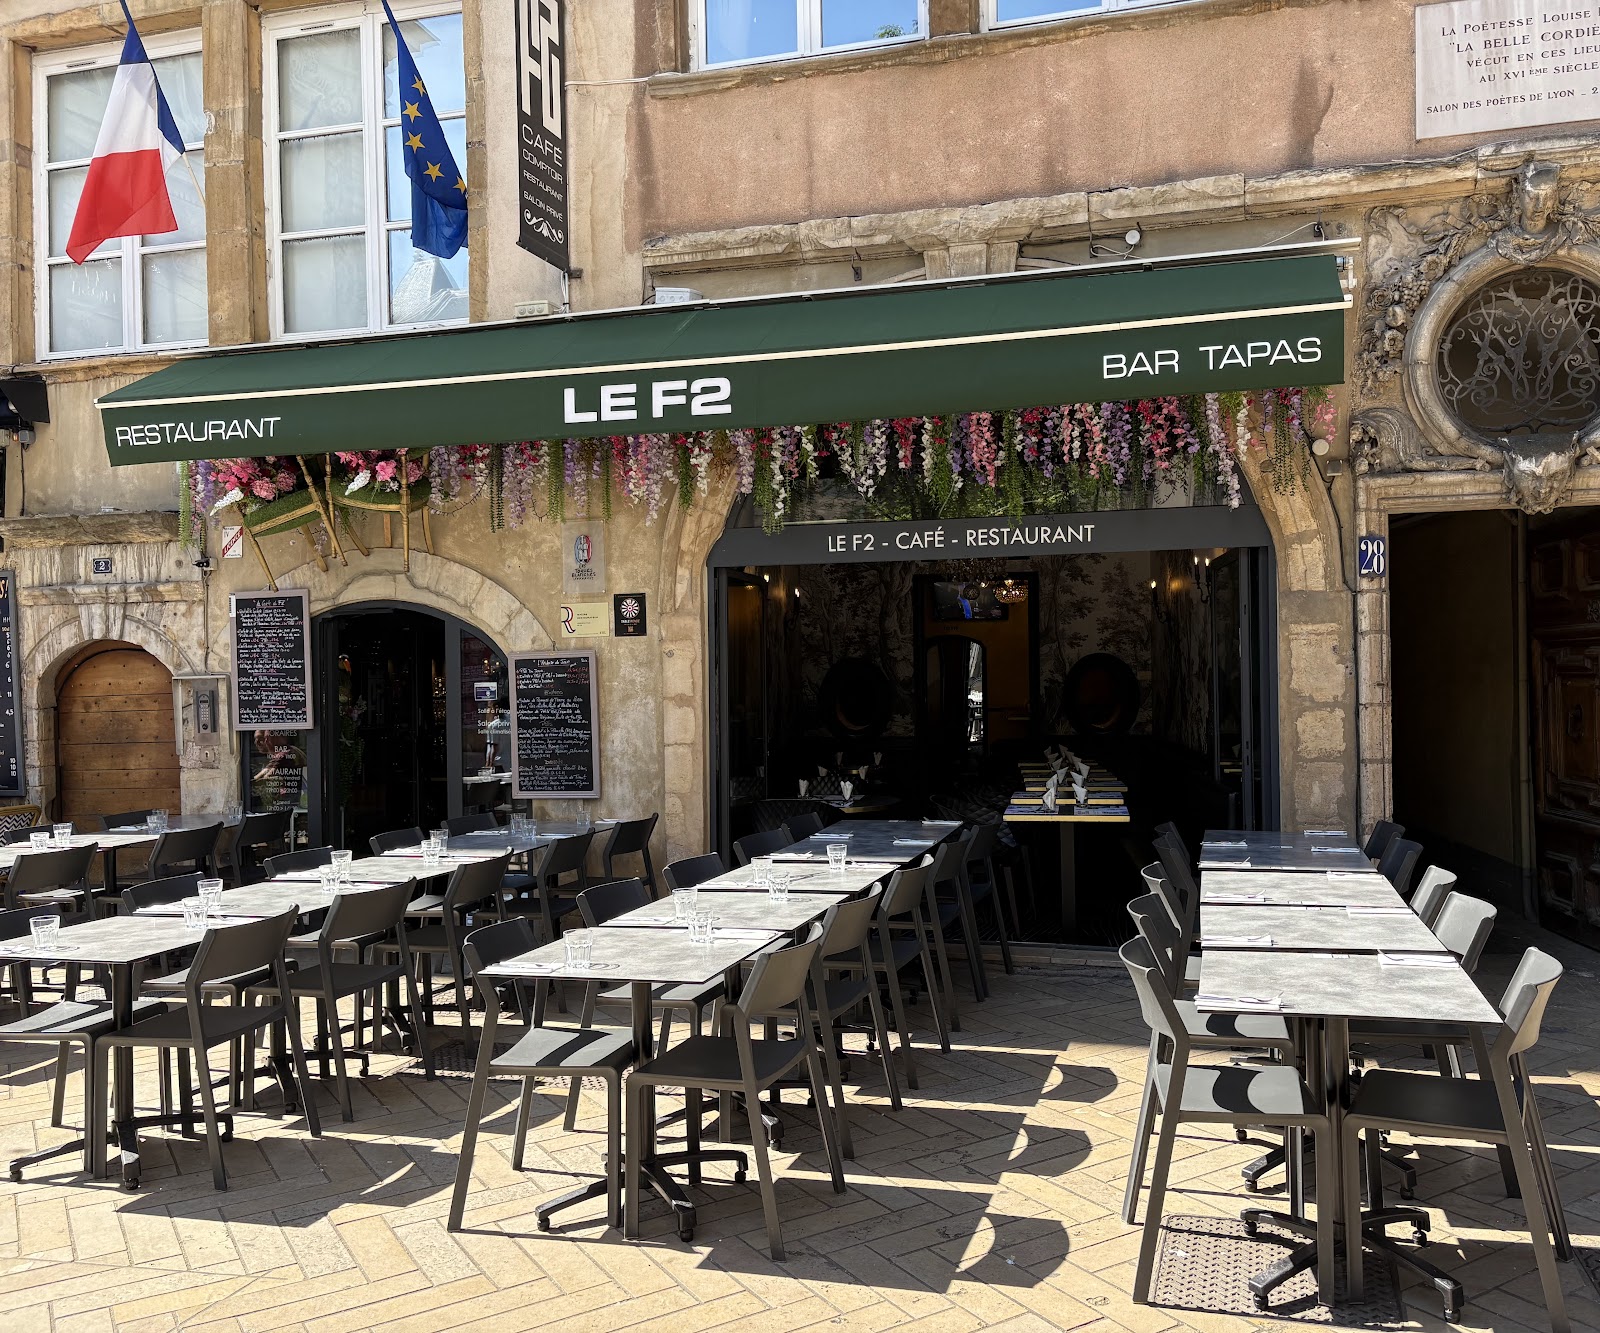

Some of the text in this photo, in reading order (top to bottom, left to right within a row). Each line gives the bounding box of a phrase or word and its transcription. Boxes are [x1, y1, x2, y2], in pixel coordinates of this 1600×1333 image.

[1442, 27, 1456, 36] LA
[1543, 10, 1591, 23] LOUISE
[1483, 35, 1531, 50] BELLE
[1466, 55, 1510, 68] VÉCUT
[1517, 52, 1534, 62] EN
[1541, 49, 1566, 59] CES
[1479, 74, 1496, 83] AU
[1553, 62, 1599, 74] SIÈCLE
[1426, 102, 1459, 114] SALON
[1463, 100, 1482, 110] DES
[1529, 92, 1543, 101] DE
[1547, 89, 1575, 99] LYON
[522, 123, 562, 167] CAFÉ
[522, 148, 563, 184] COMPTOIR
[523, 169, 563, 202] RESTAURANT
[523, 190, 563, 223] SALON PRIVÉ
[1102, 337, 1322, 379] BAR TAPAS
[564, 377, 732, 424] LE F2
[115, 416, 282, 447] RESTAURANT
[828, 535, 846, 552] LE
[852, 534, 874, 551] F2
[895, 526, 945, 550] CAFÉ
[966, 524, 1095, 547] RESTAURANT
[99, 561, 106, 570] 2
[1360, 539, 1385, 575] 28
[496, 707, 511, 715] l'étag
[497, 720, 511, 728] priv
[274, 745, 288, 753] BAR
